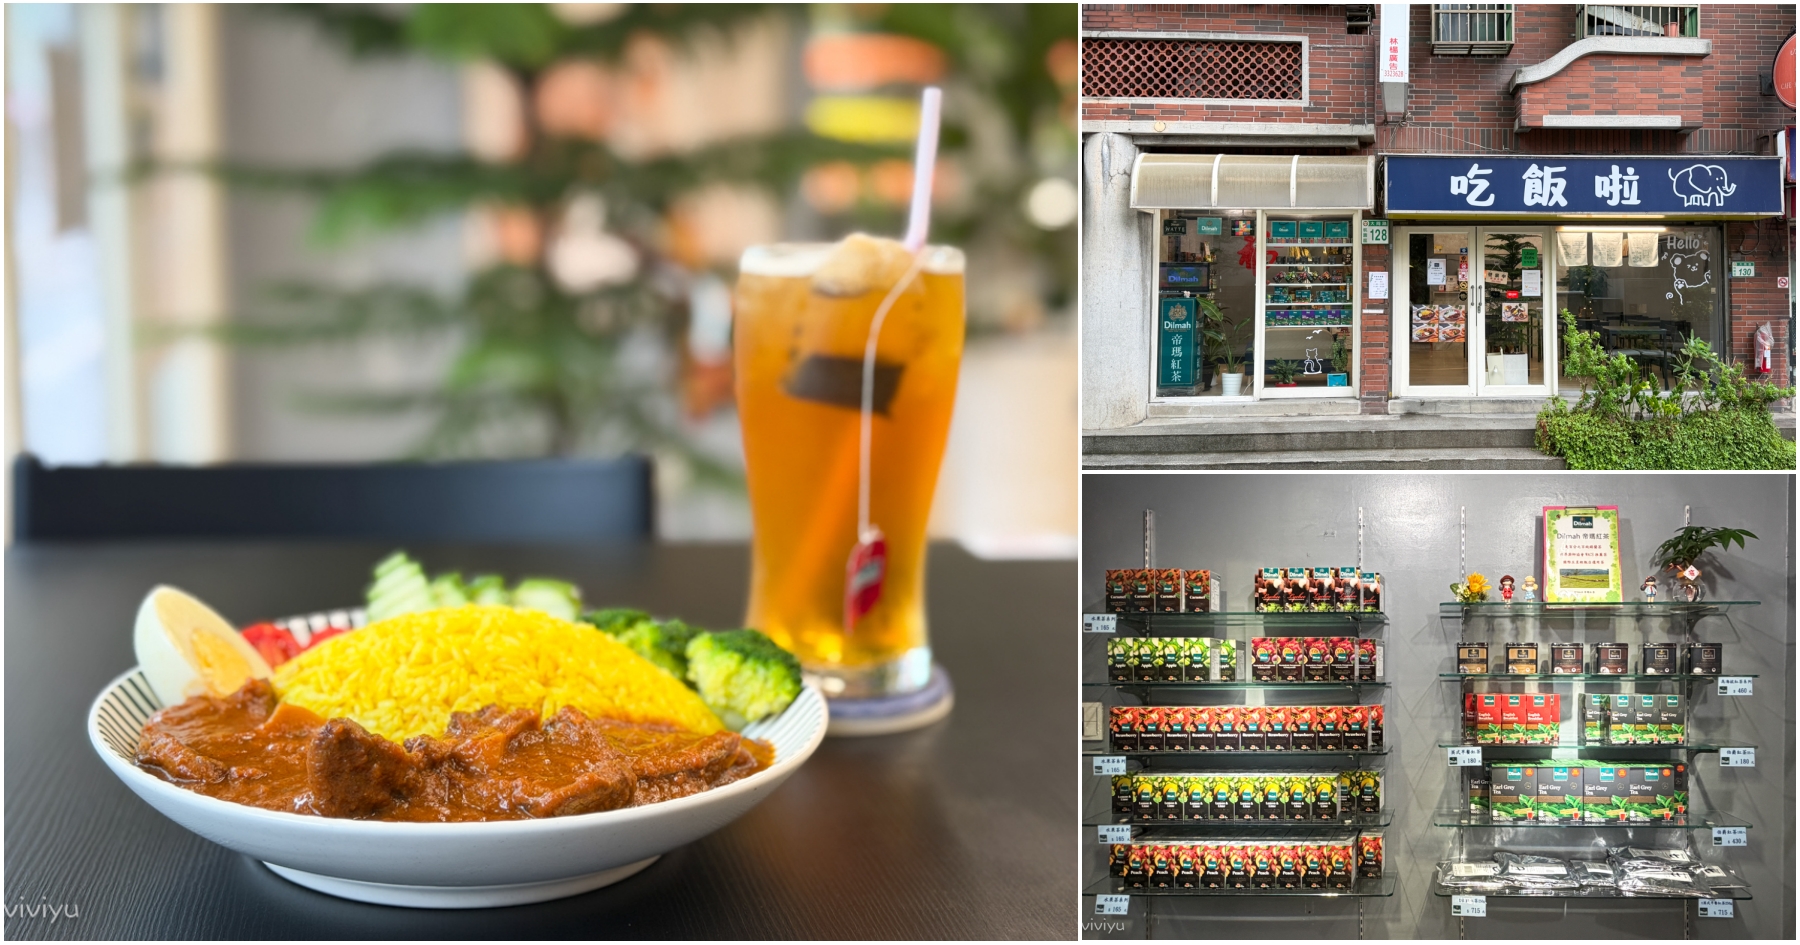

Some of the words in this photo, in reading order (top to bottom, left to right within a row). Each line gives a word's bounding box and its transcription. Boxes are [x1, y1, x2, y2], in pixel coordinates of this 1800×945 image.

[1450, 163, 1641, 207] 吃飯啦
[1370, 229, 1388, 241] 128
[1667, 236, 1700, 250] Hello
[1738, 268, 1752, 276] 130
[1164, 321, 1191, 329] Dilmah
[1171, 334, 1182, 382] 帝瑪紅茶
